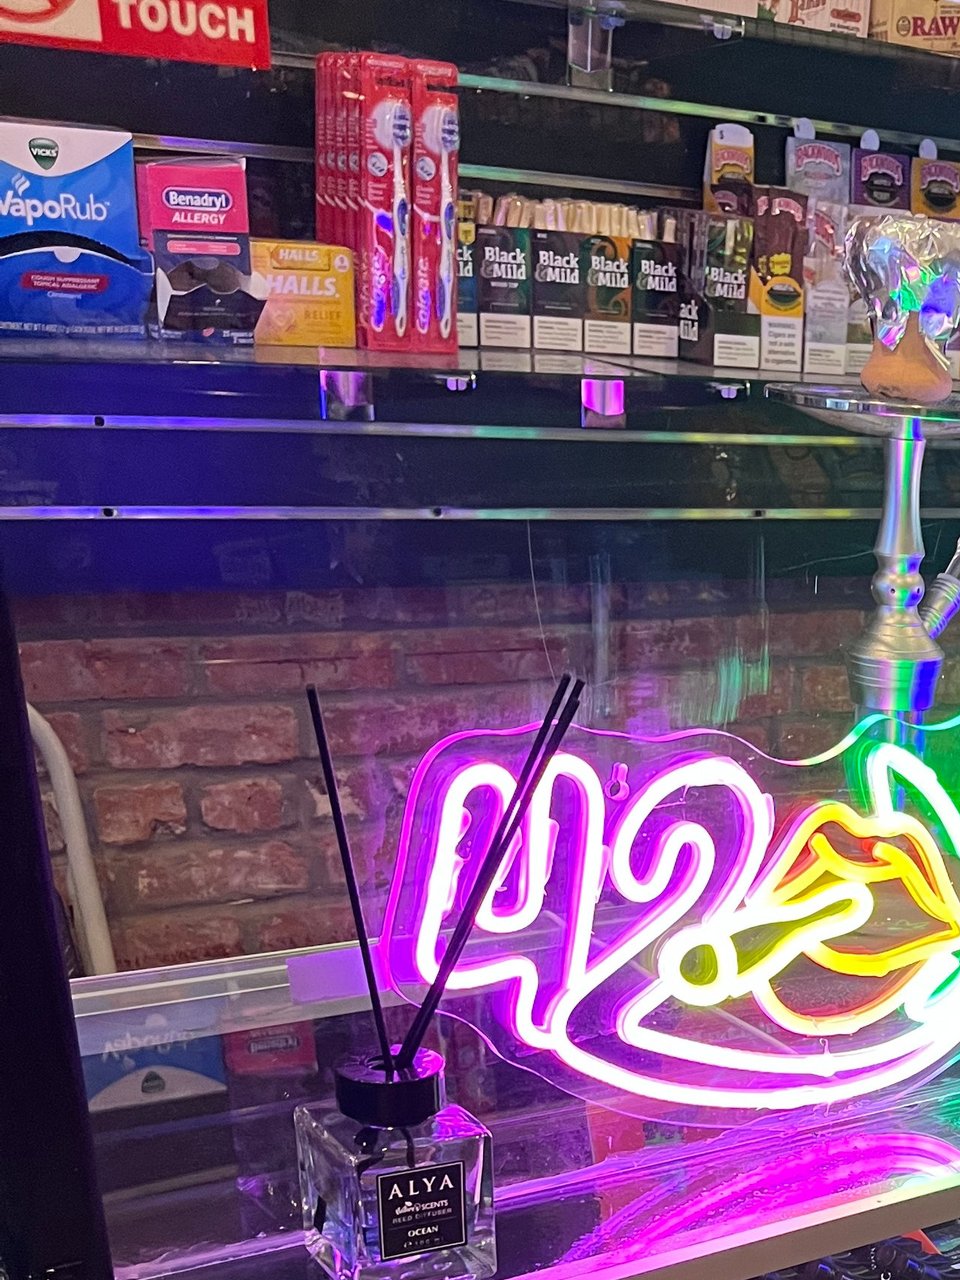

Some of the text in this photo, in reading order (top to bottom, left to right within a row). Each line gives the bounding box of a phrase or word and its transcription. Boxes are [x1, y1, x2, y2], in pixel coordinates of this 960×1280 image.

[110, 0, 257, 44] TOUCH
[30, 146, 57, 158] VICKS
[168, 190, 227, 211] Benadryl
[171, 211, 227, 226] ALLERGY
[279, 249, 318, 261] HALLS
[484, 246, 526, 264] Black
[539, 250, 580, 269] Black
[493, 263, 527, 281] Mild
[591, 255, 629, 274] Black
[640, 259, 678, 277] Black
[548, 267, 580, 285] Mild
[598, 271, 629, 289] Mild
[646, 276, 678, 293] Mild
[710, 267, 747, 286] Black
[266, 274, 340, 298] HALLS
[714, 282, 746, 300] Mild
[388, 1174, 454, 1200] ALYA
[421, 1199, 449, 1211] SCENTS
[408, 1225, 440, 1238] OCEAN
